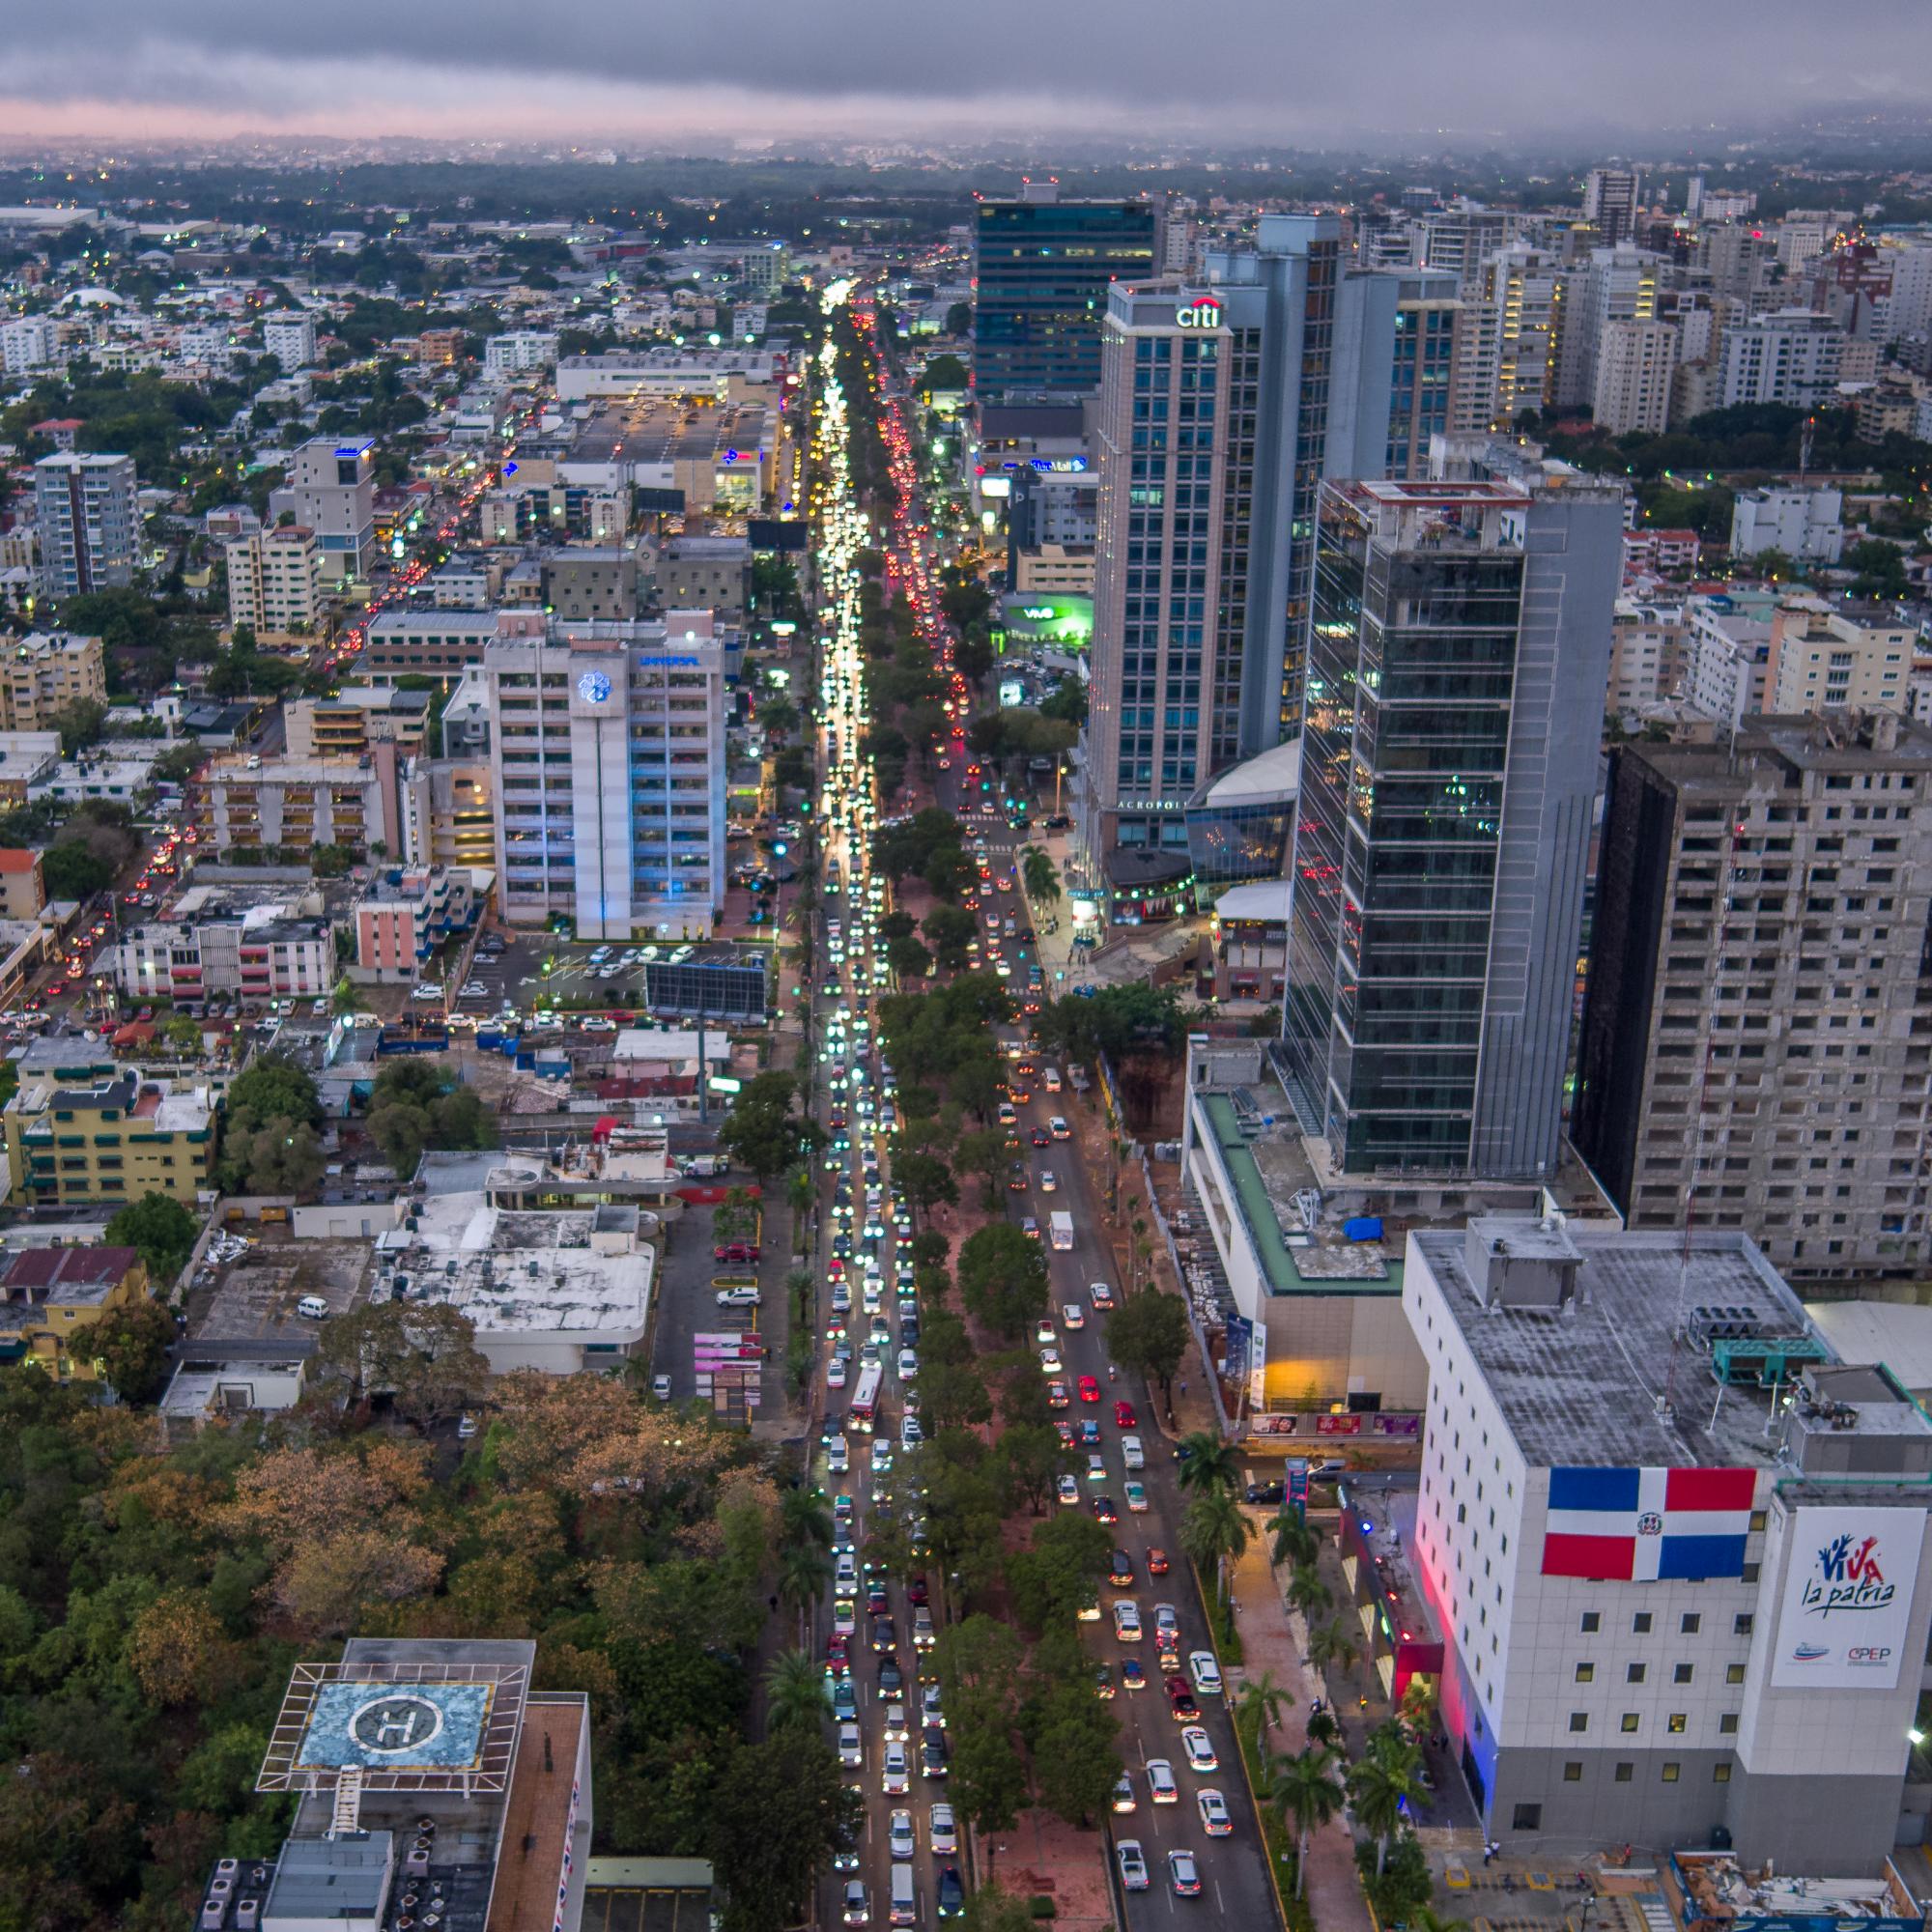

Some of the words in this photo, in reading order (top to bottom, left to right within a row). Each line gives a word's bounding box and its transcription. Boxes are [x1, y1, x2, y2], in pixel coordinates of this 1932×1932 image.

[1176, 303, 1218, 328] citi
[1802, 1577, 1822, 1605] la
[1823, 1576, 1895, 1619] patria
[377, 1711, 416, 1743] H
